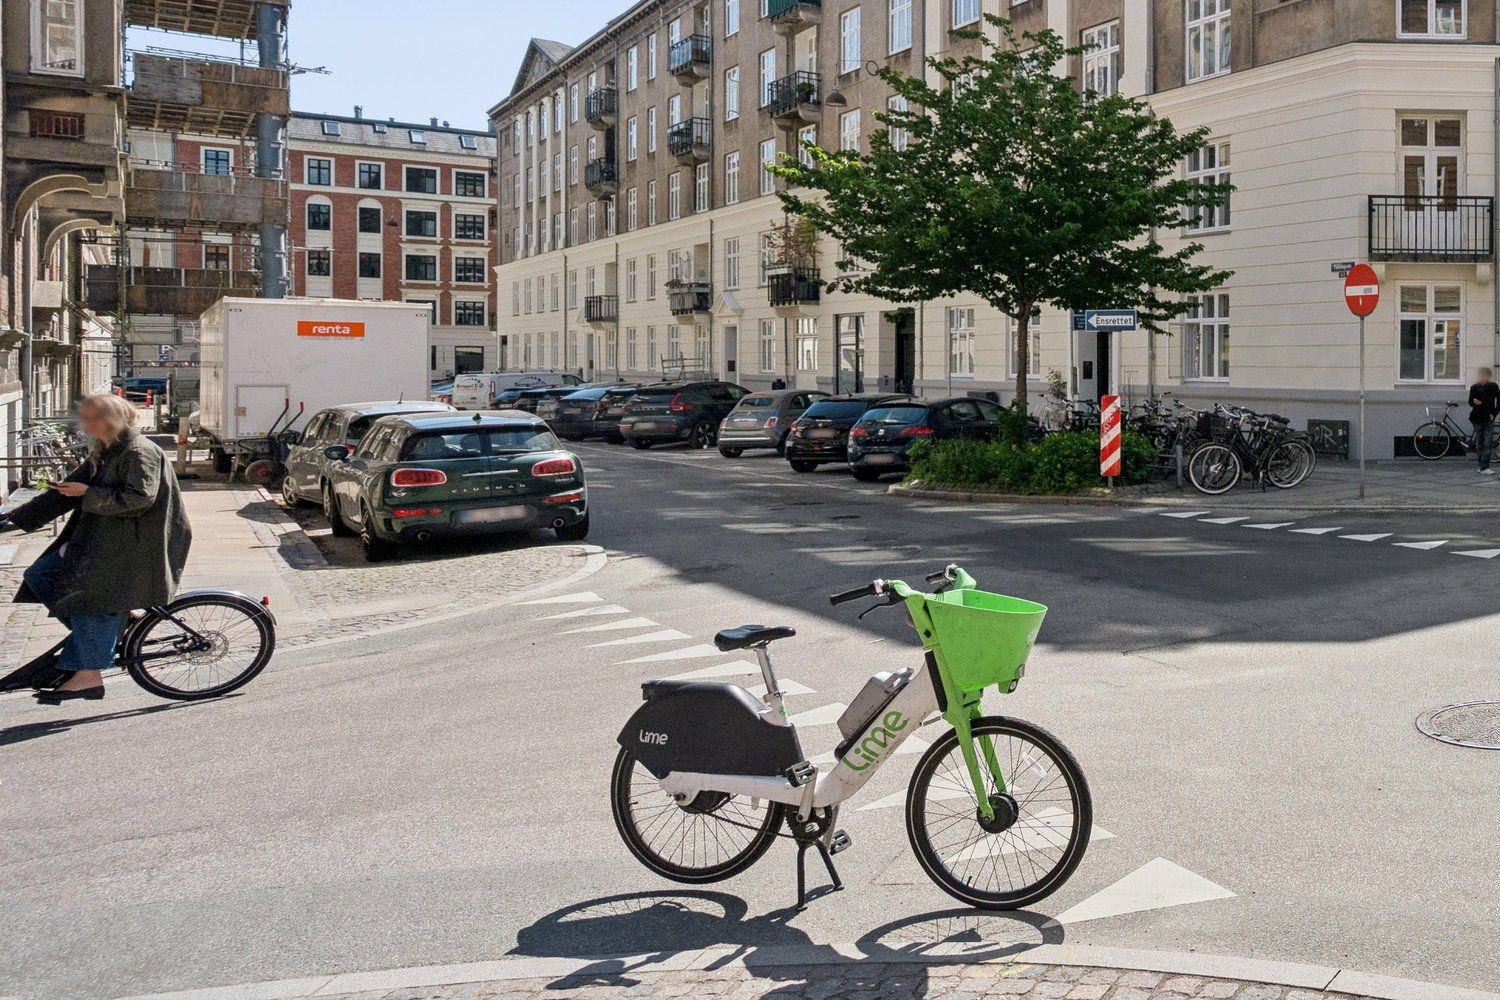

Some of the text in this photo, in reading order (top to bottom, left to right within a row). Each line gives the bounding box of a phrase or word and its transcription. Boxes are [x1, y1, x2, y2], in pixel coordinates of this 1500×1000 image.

[1095, 316, 1132, 325] Ensrettet
[312, 325, 350, 334] renta
[639, 729, 668, 745] Lime
[842, 711, 909, 771] Lime
